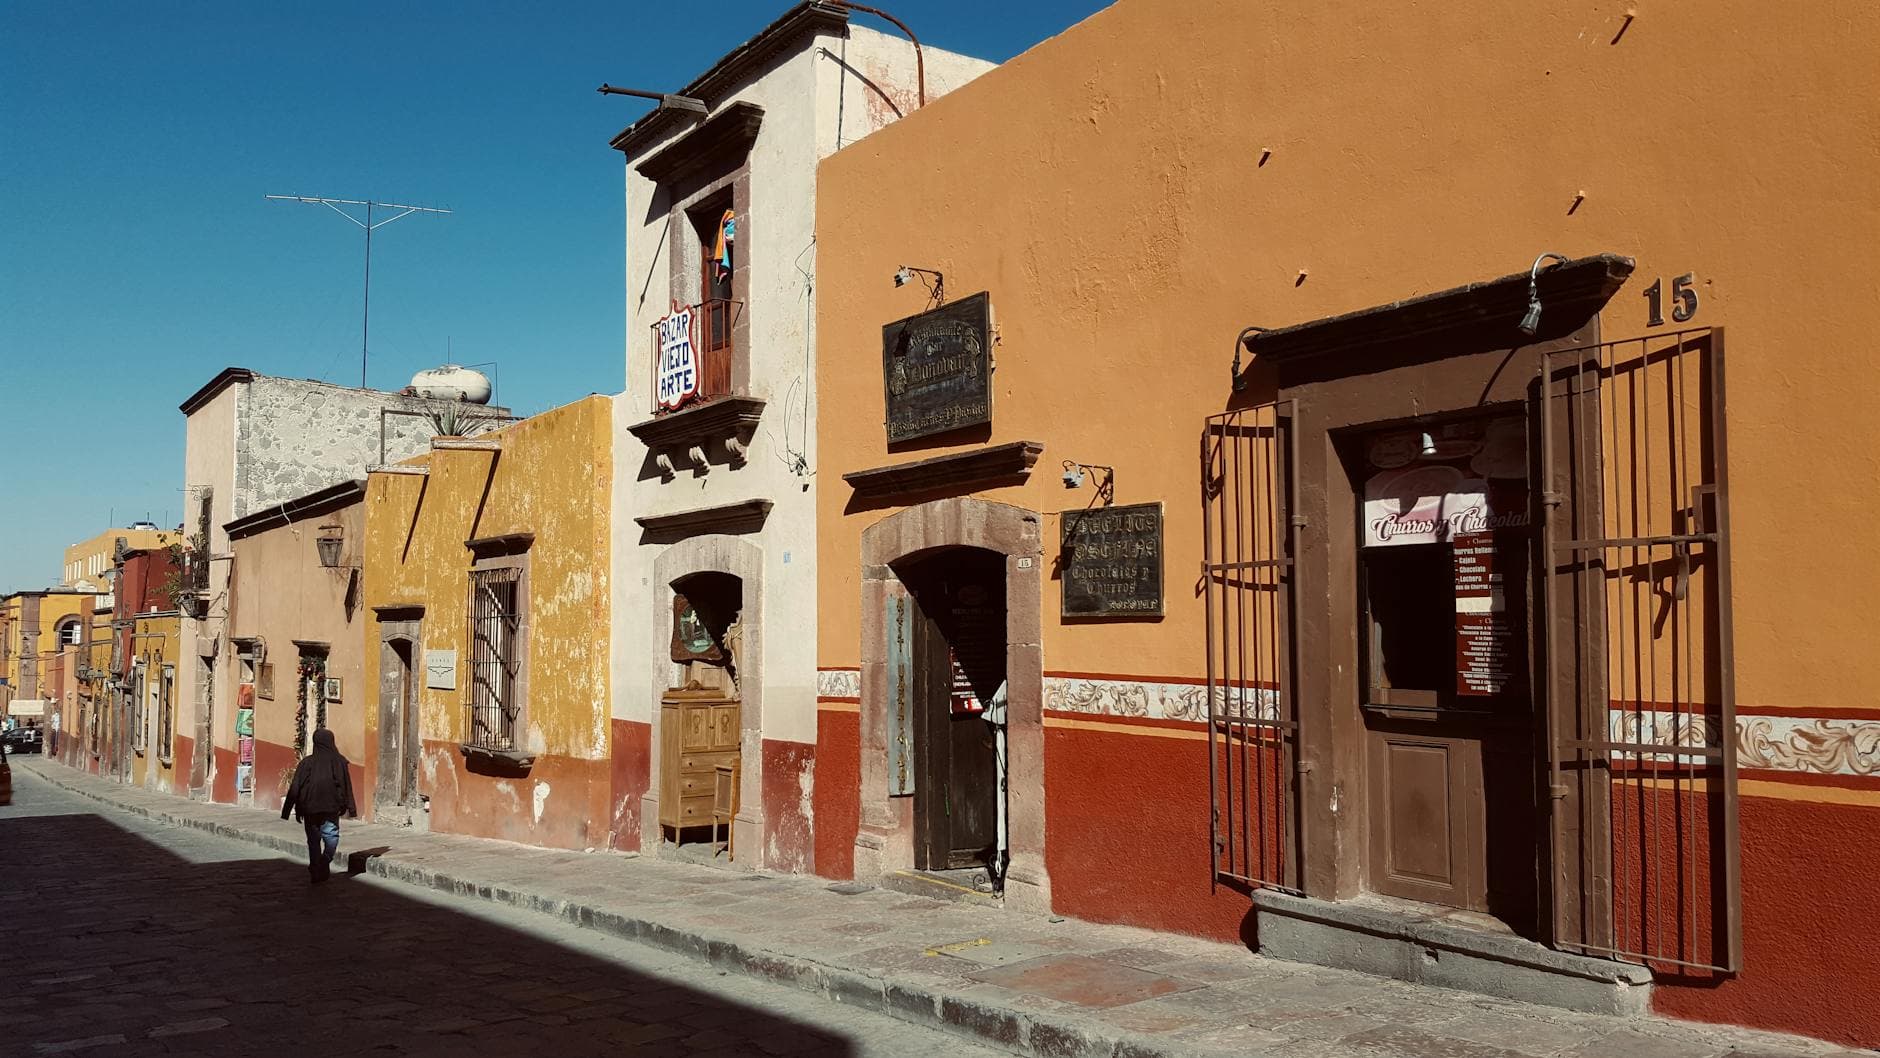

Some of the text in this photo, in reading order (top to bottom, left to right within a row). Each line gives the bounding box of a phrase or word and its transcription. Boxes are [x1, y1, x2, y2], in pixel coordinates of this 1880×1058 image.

[1643, 272, 1698, 327] 15
[662, 314, 688, 345] BAZAR
[661, 369, 693, 399] ARTE
[1371, 513, 1434, 541] Churros
[1021, 559, 1029, 567] 15
